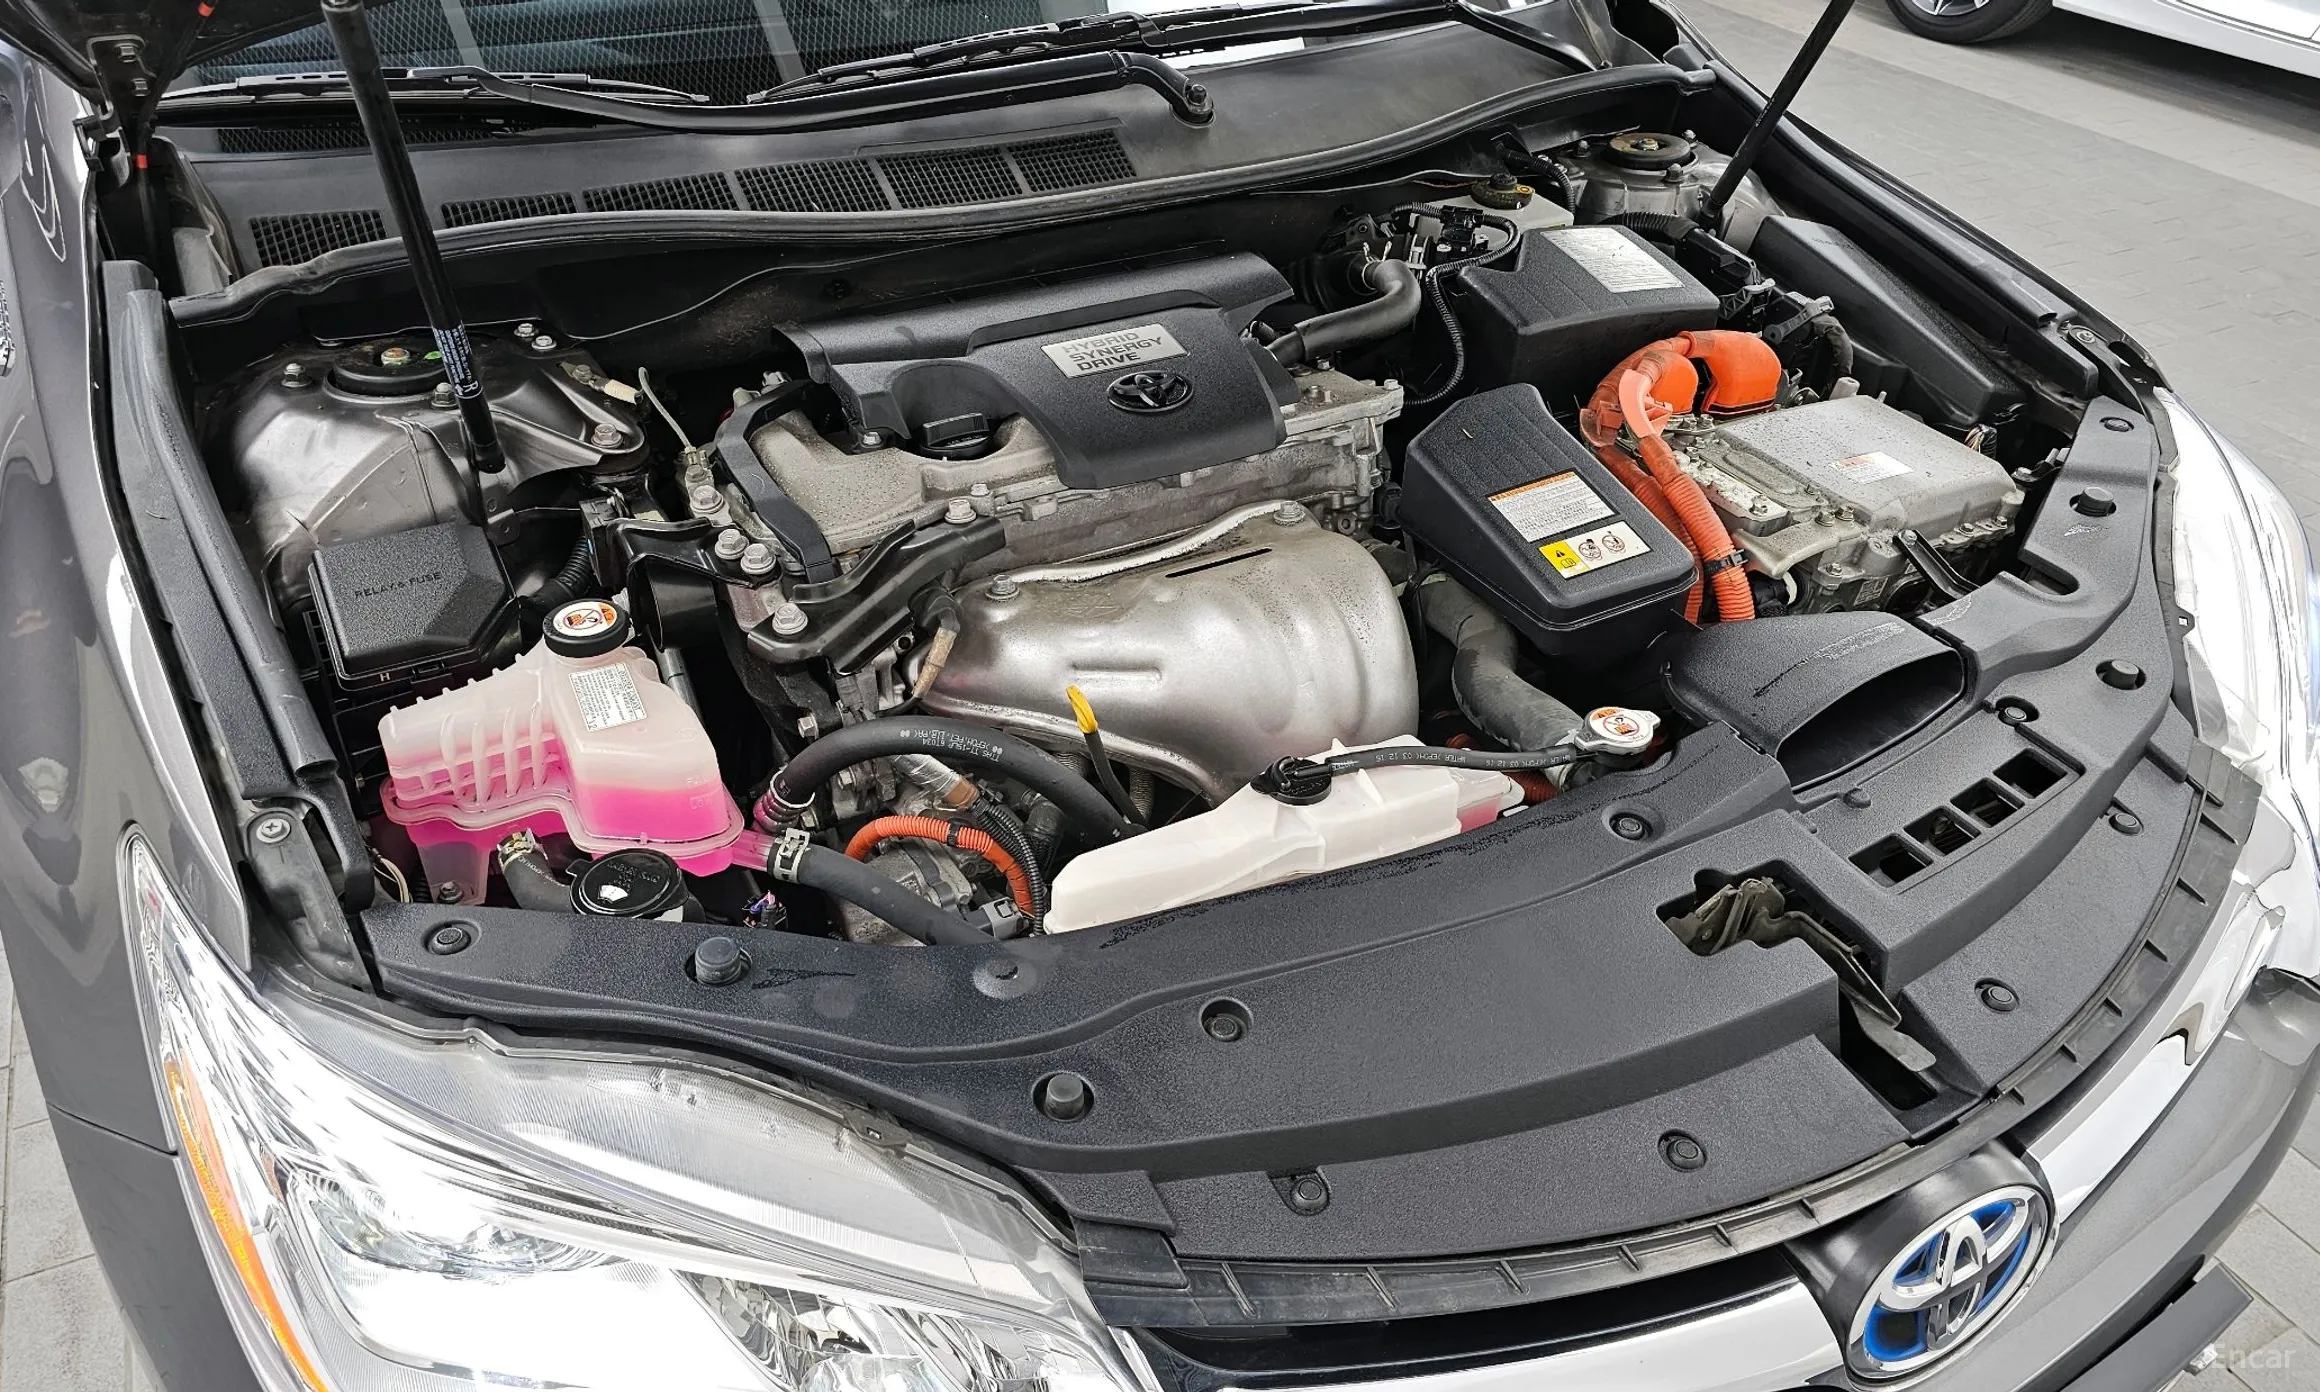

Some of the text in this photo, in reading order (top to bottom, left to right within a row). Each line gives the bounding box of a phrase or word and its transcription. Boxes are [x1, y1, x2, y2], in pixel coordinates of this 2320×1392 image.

[1062, 332, 1140, 353] HYBRID
[1069, 336, 1163, 362] SYNERGY
[1076, 351, 1141, 371] DRIVE
[354, 583, 395, 599] RELAY
[408, 572, 441, 585] FUSE
